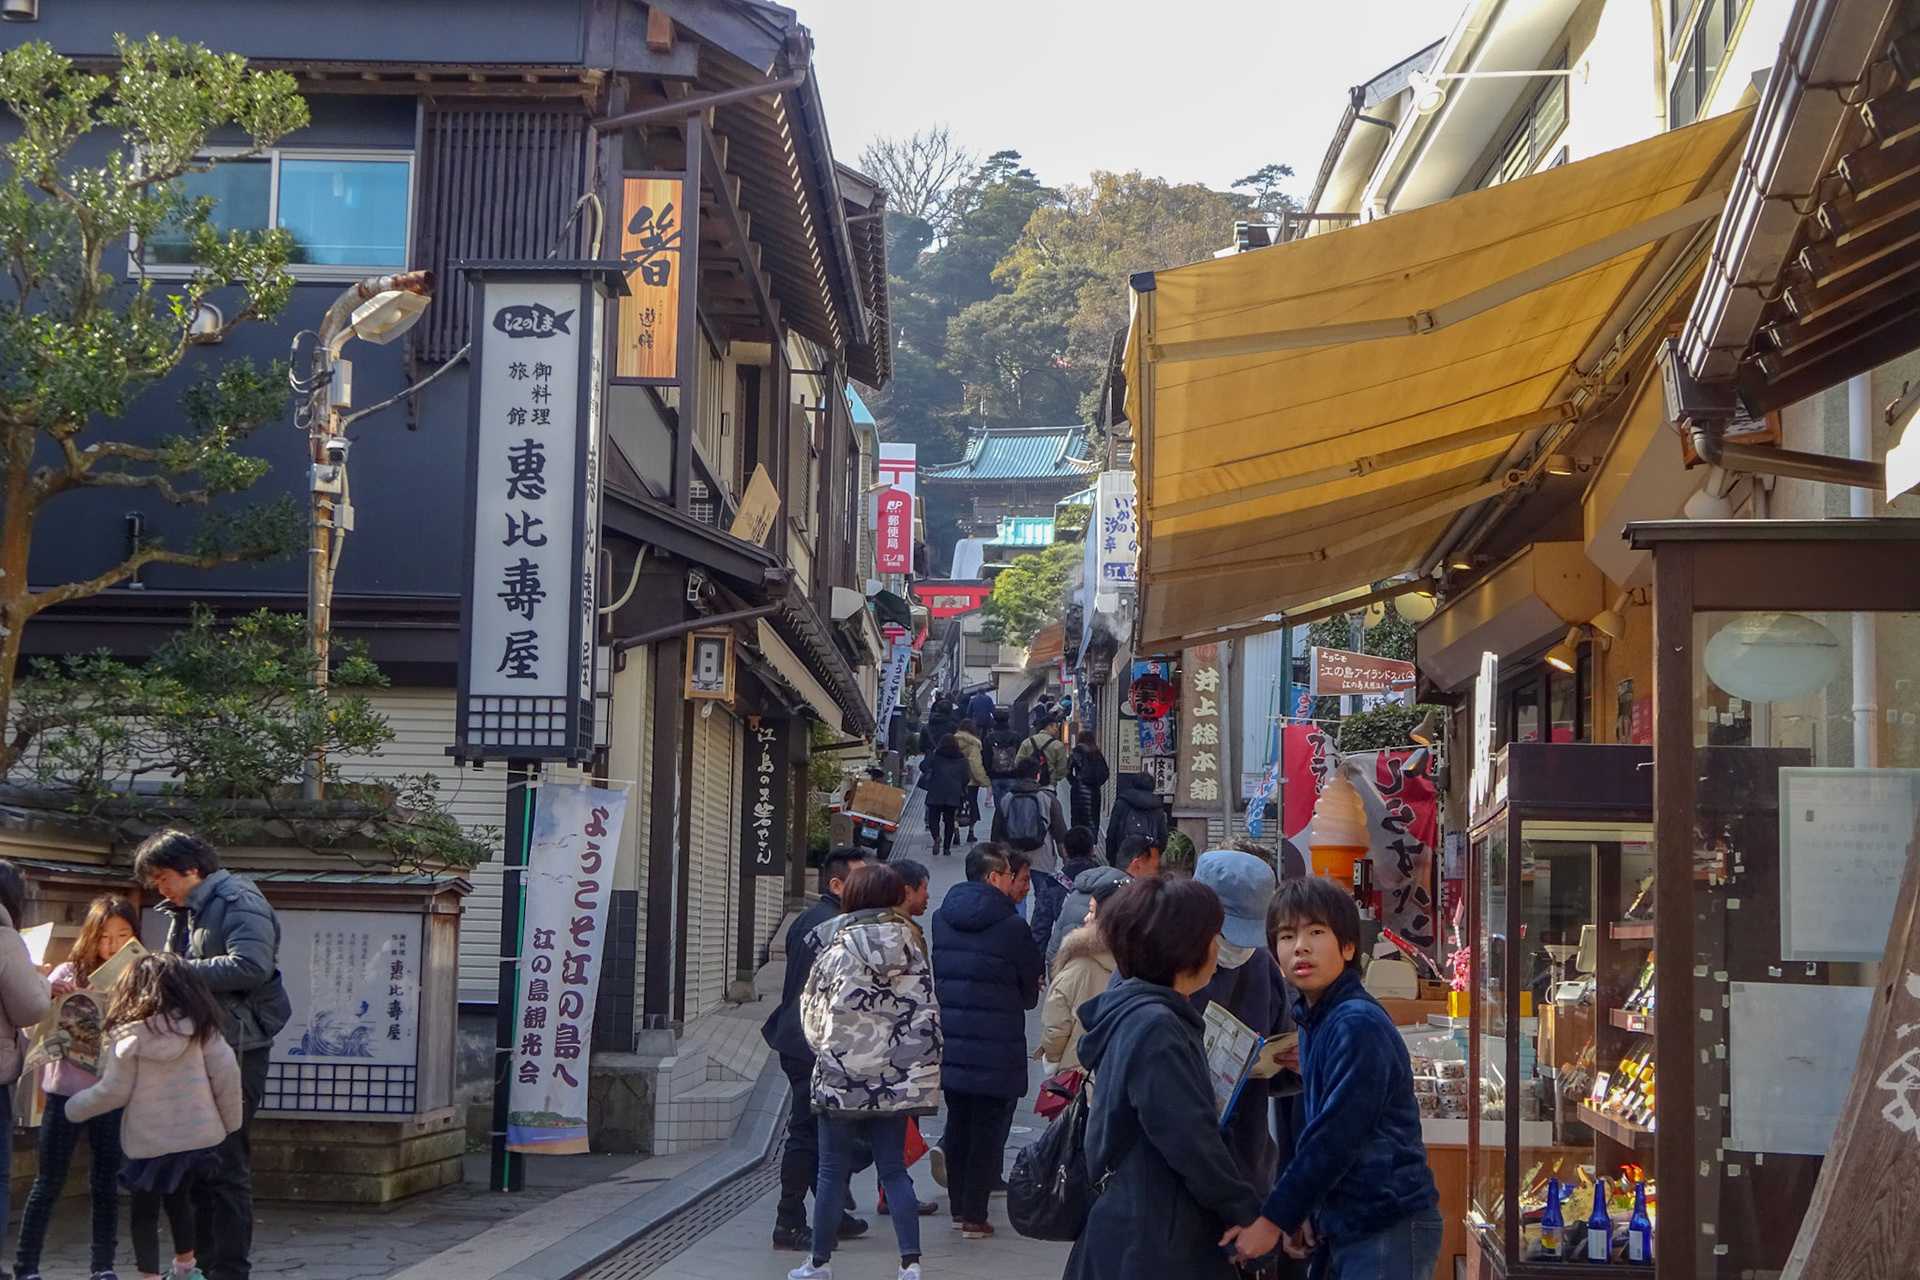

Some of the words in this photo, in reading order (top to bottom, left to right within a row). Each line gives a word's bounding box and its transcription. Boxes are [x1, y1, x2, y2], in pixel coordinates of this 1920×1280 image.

[621, 202, 681, 287] 箸
[507, 362, 529, 426] 旅館
[531, 362, 552, 426] 御料理
[887, 515, 900, 549] 郵便局
[1114, 498, 1130, 533] いかの
[1321, 651, 1347, 663] ようこそ
[1190, 667, 1220, 800] 井上総本舗
[552, 806, 610, 1088] ようこそ江の島へ
[518, 928, 556, 1085] 江の島観光会
